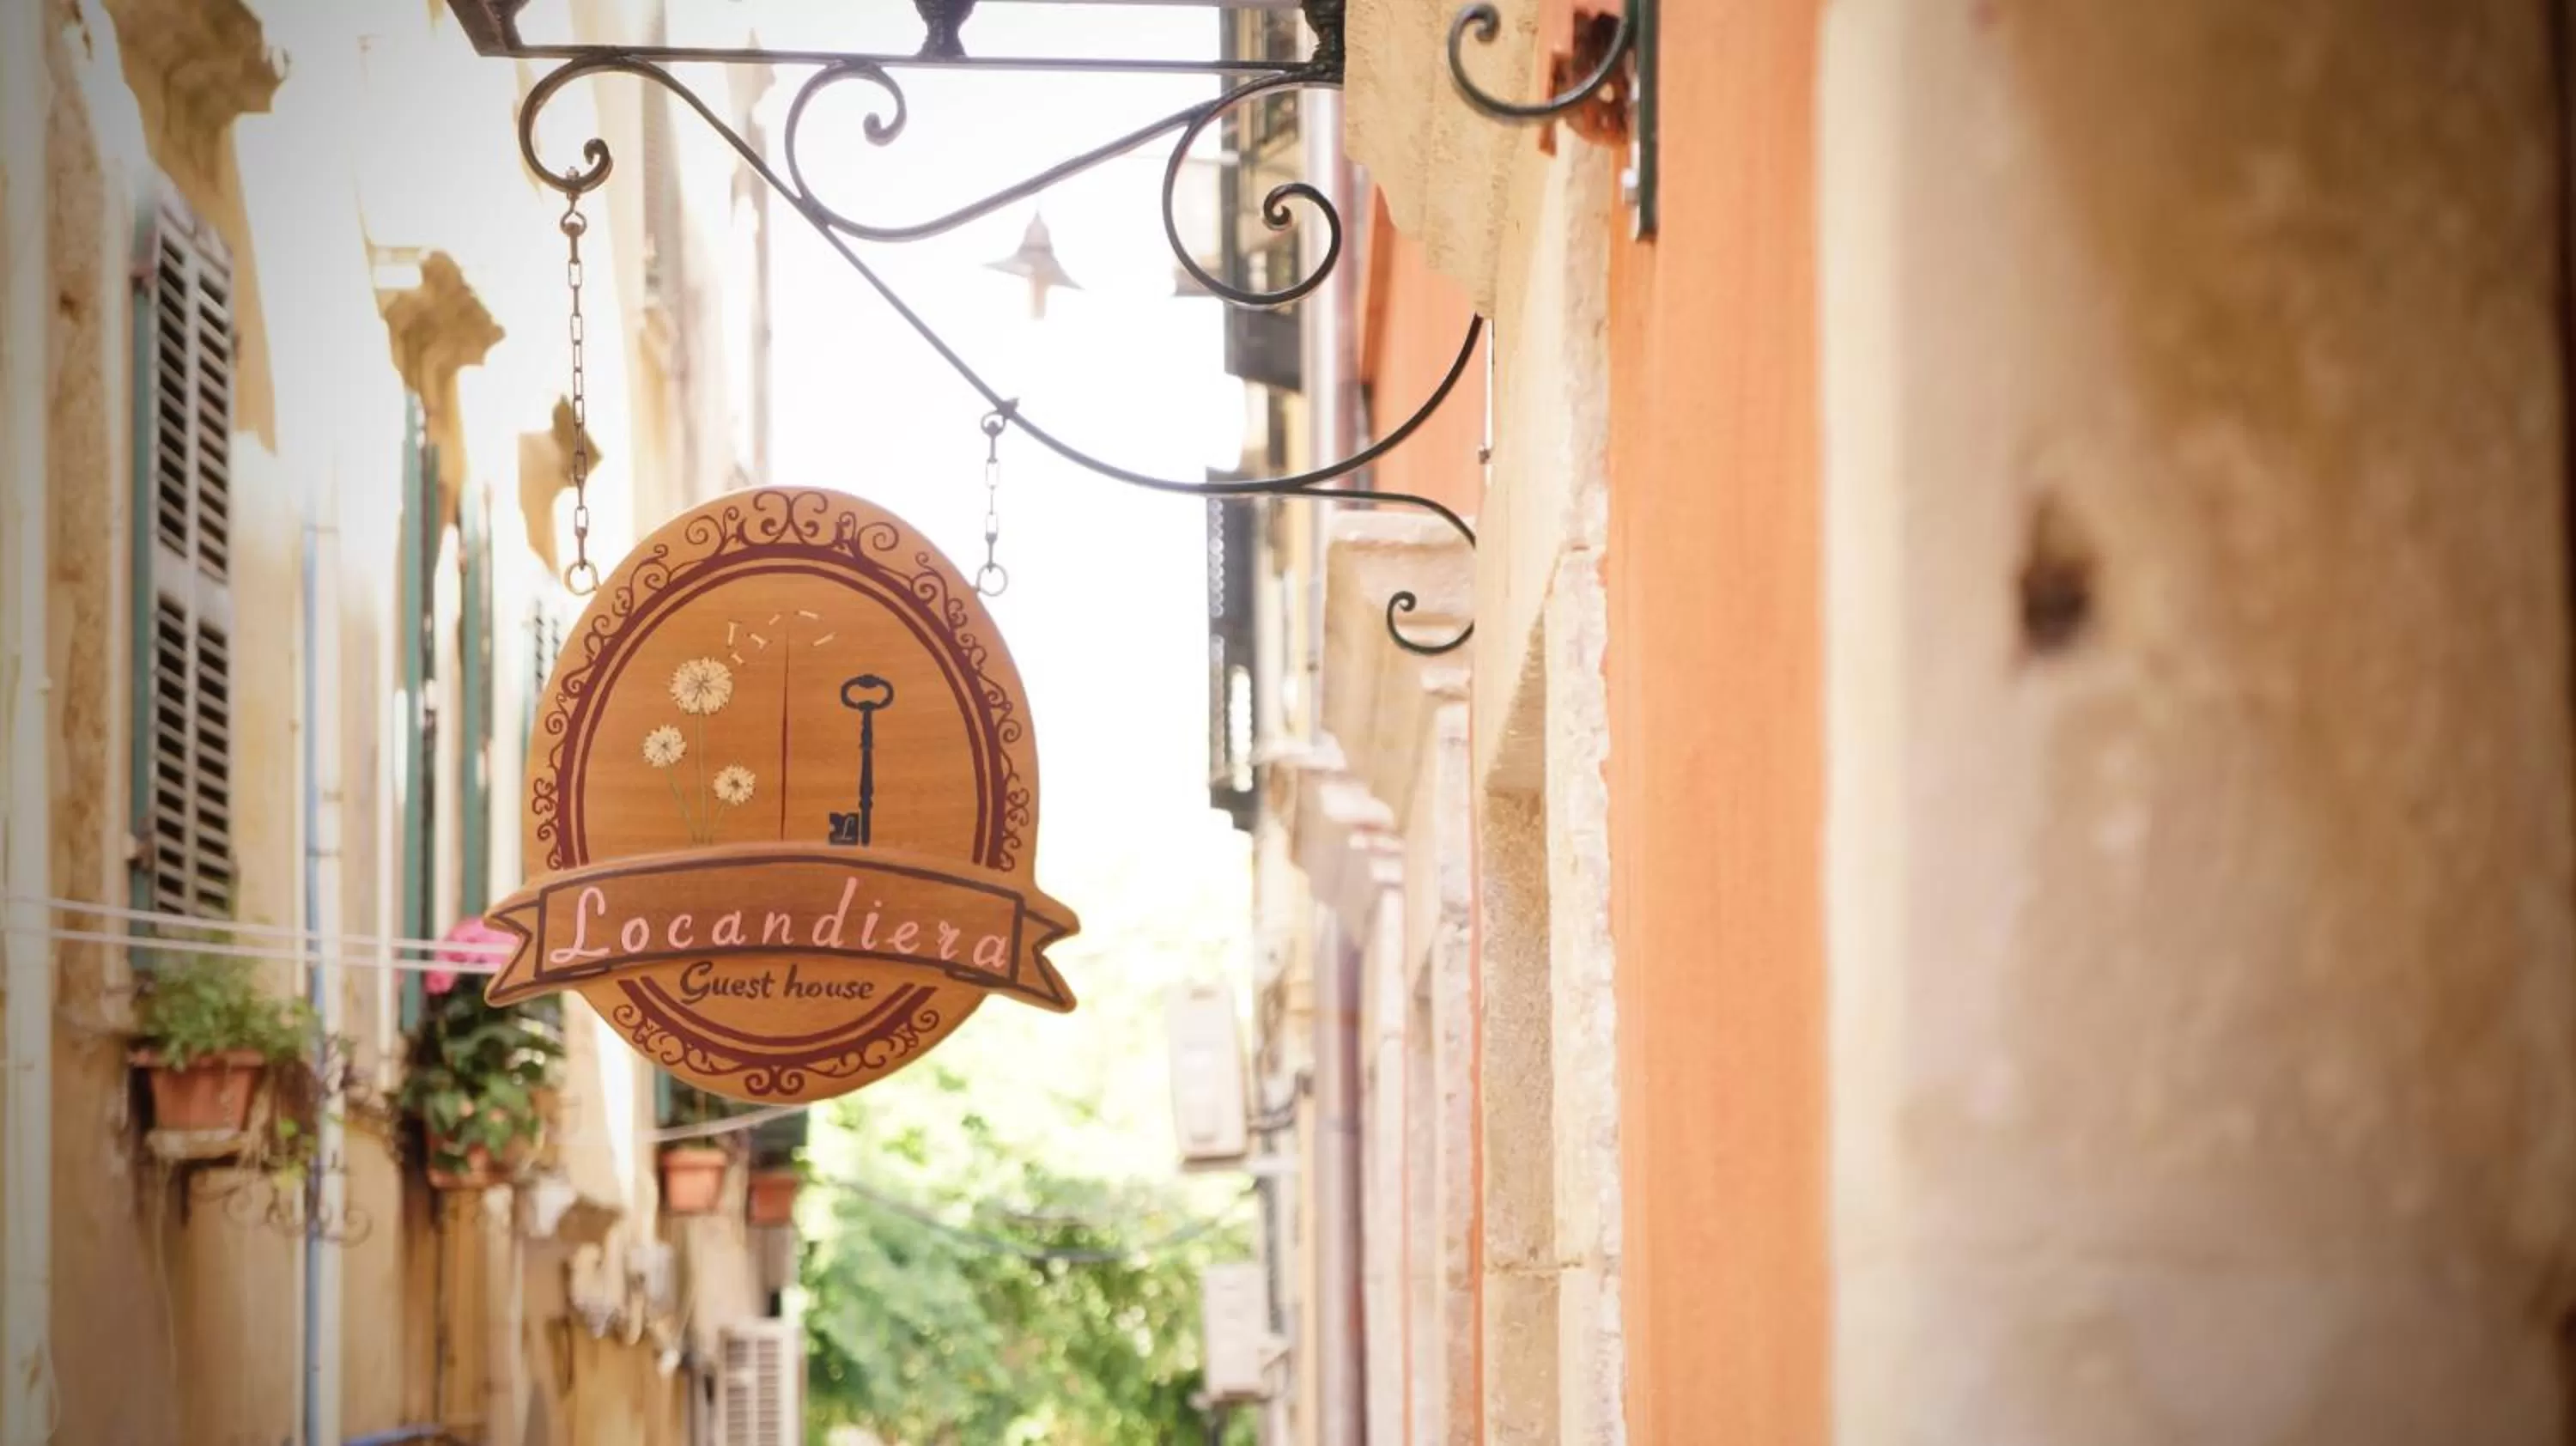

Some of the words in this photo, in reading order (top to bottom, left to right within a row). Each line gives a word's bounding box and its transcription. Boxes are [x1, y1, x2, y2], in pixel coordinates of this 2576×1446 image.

[549, 876, 1008, 969] Locandiera
[679, 960, 775, 1005] Guest
[783, 962, 875, 1000] house
